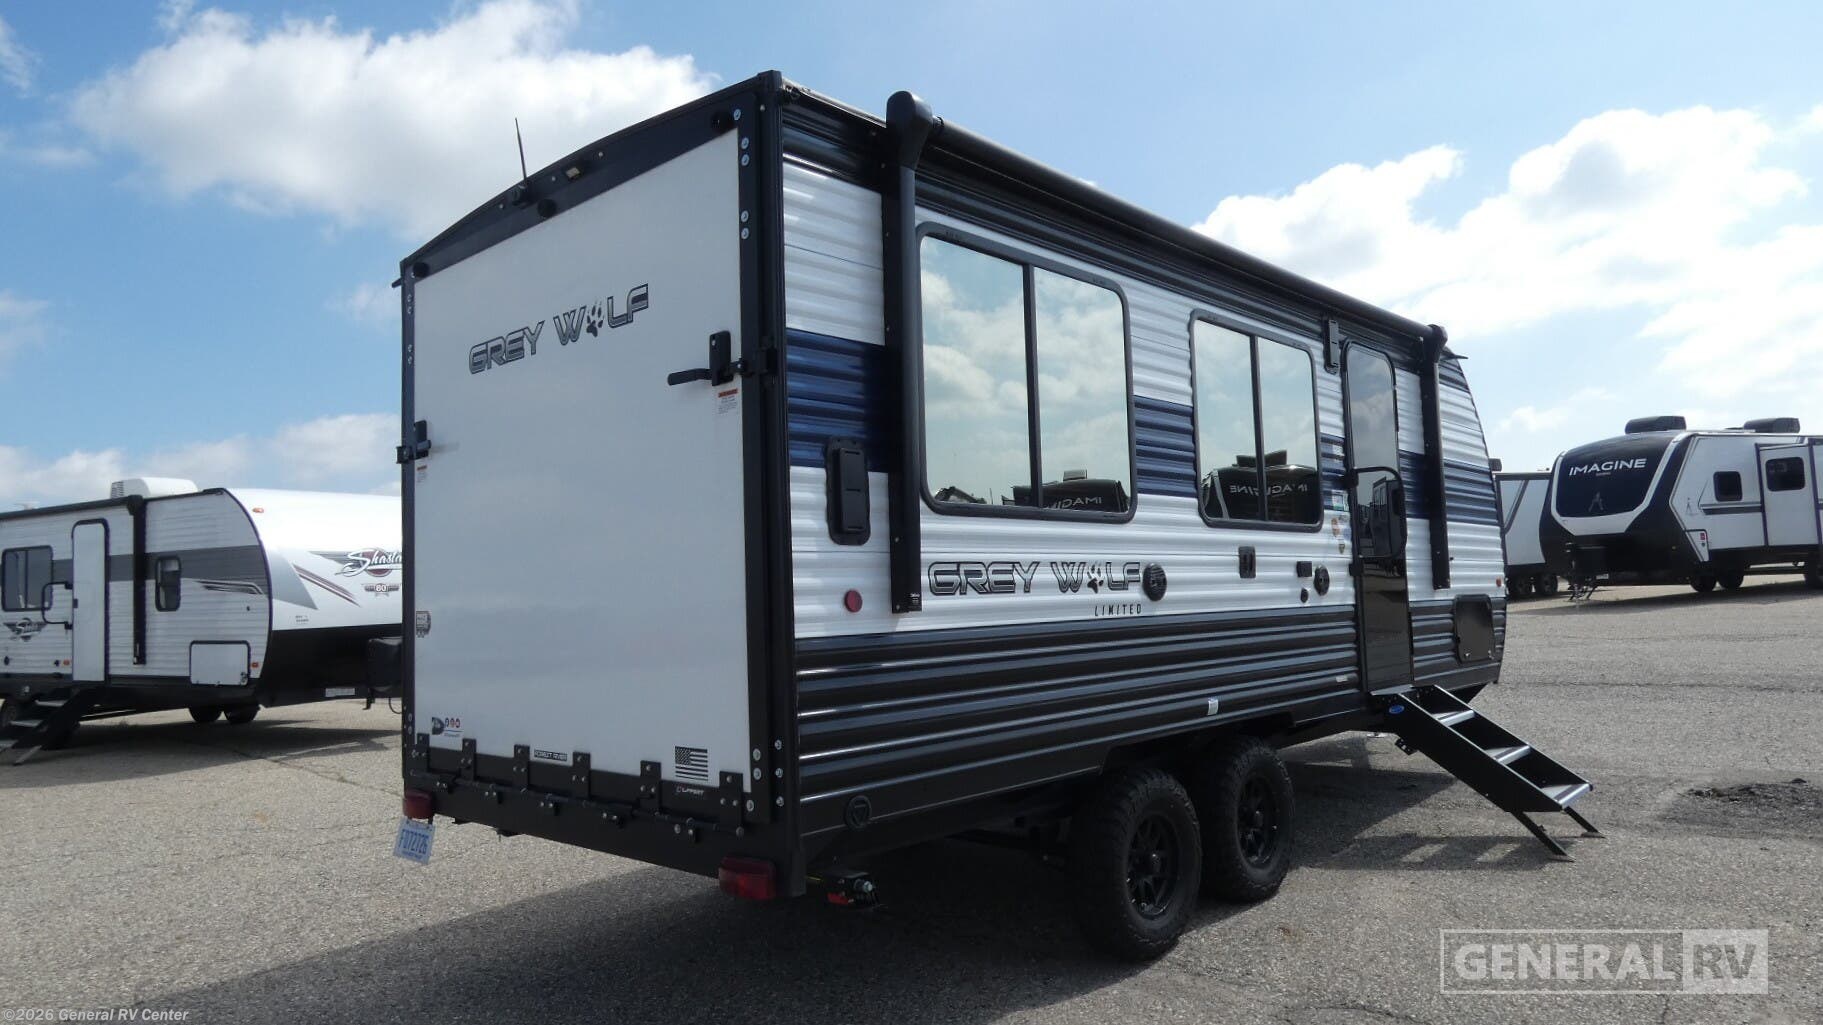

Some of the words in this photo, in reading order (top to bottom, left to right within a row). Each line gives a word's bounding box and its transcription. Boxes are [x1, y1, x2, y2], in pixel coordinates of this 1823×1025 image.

[469, 320, 545, 374] GREY
[1568, 458, 1647, 476] IMAGINE
[928, 561, 1040, 596] GREY
[1094, 603, 1142, 617] LIMITED
